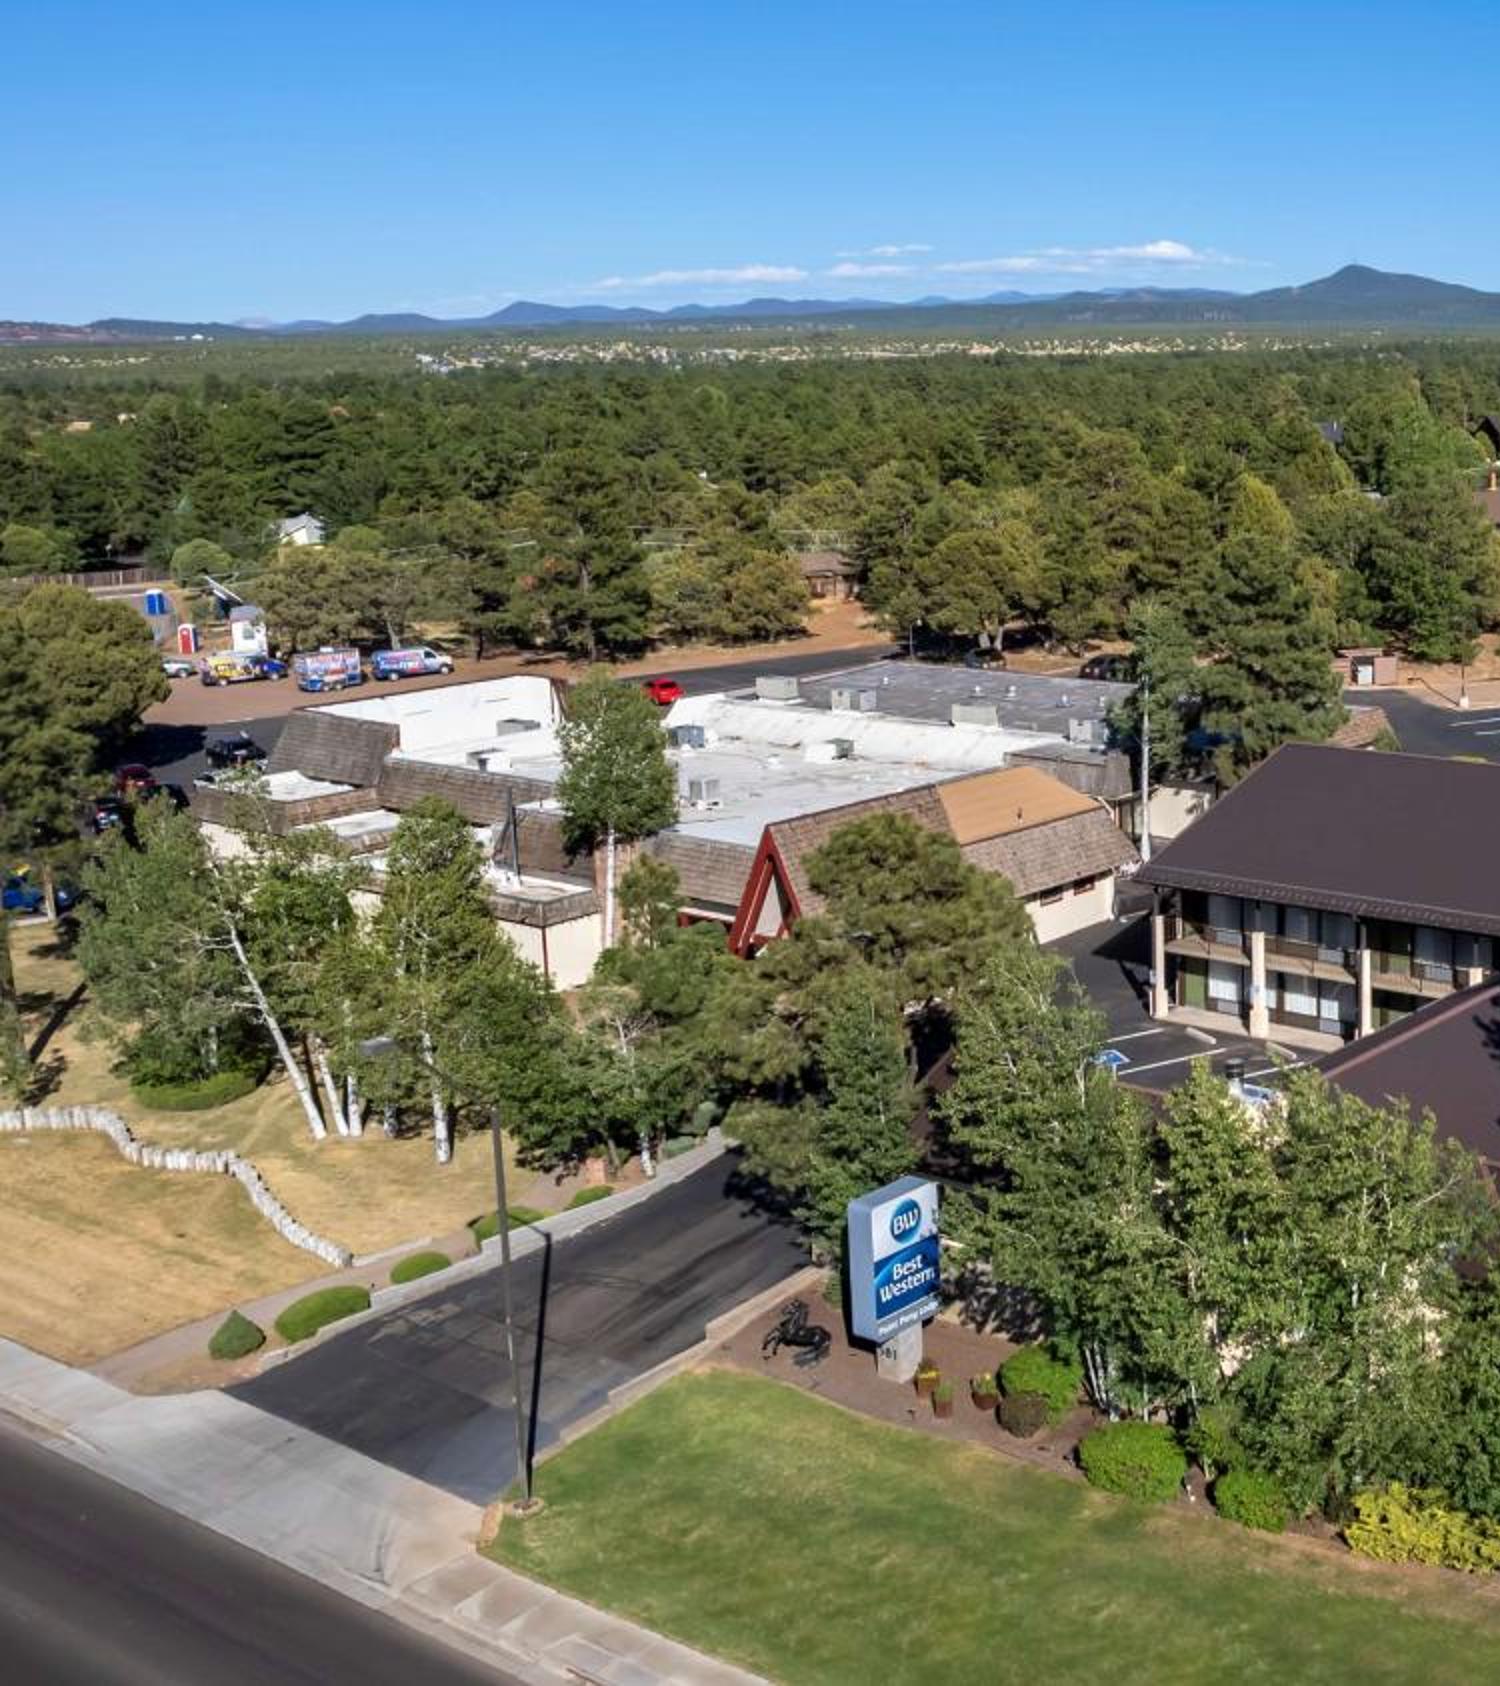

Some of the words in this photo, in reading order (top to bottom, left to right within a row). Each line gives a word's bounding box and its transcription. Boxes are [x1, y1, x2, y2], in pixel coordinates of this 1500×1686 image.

[893, 1208, 919, 1235] BW
[893, 1254, 922, 1281] Best
[880, 1267, 935, 1303] Western
